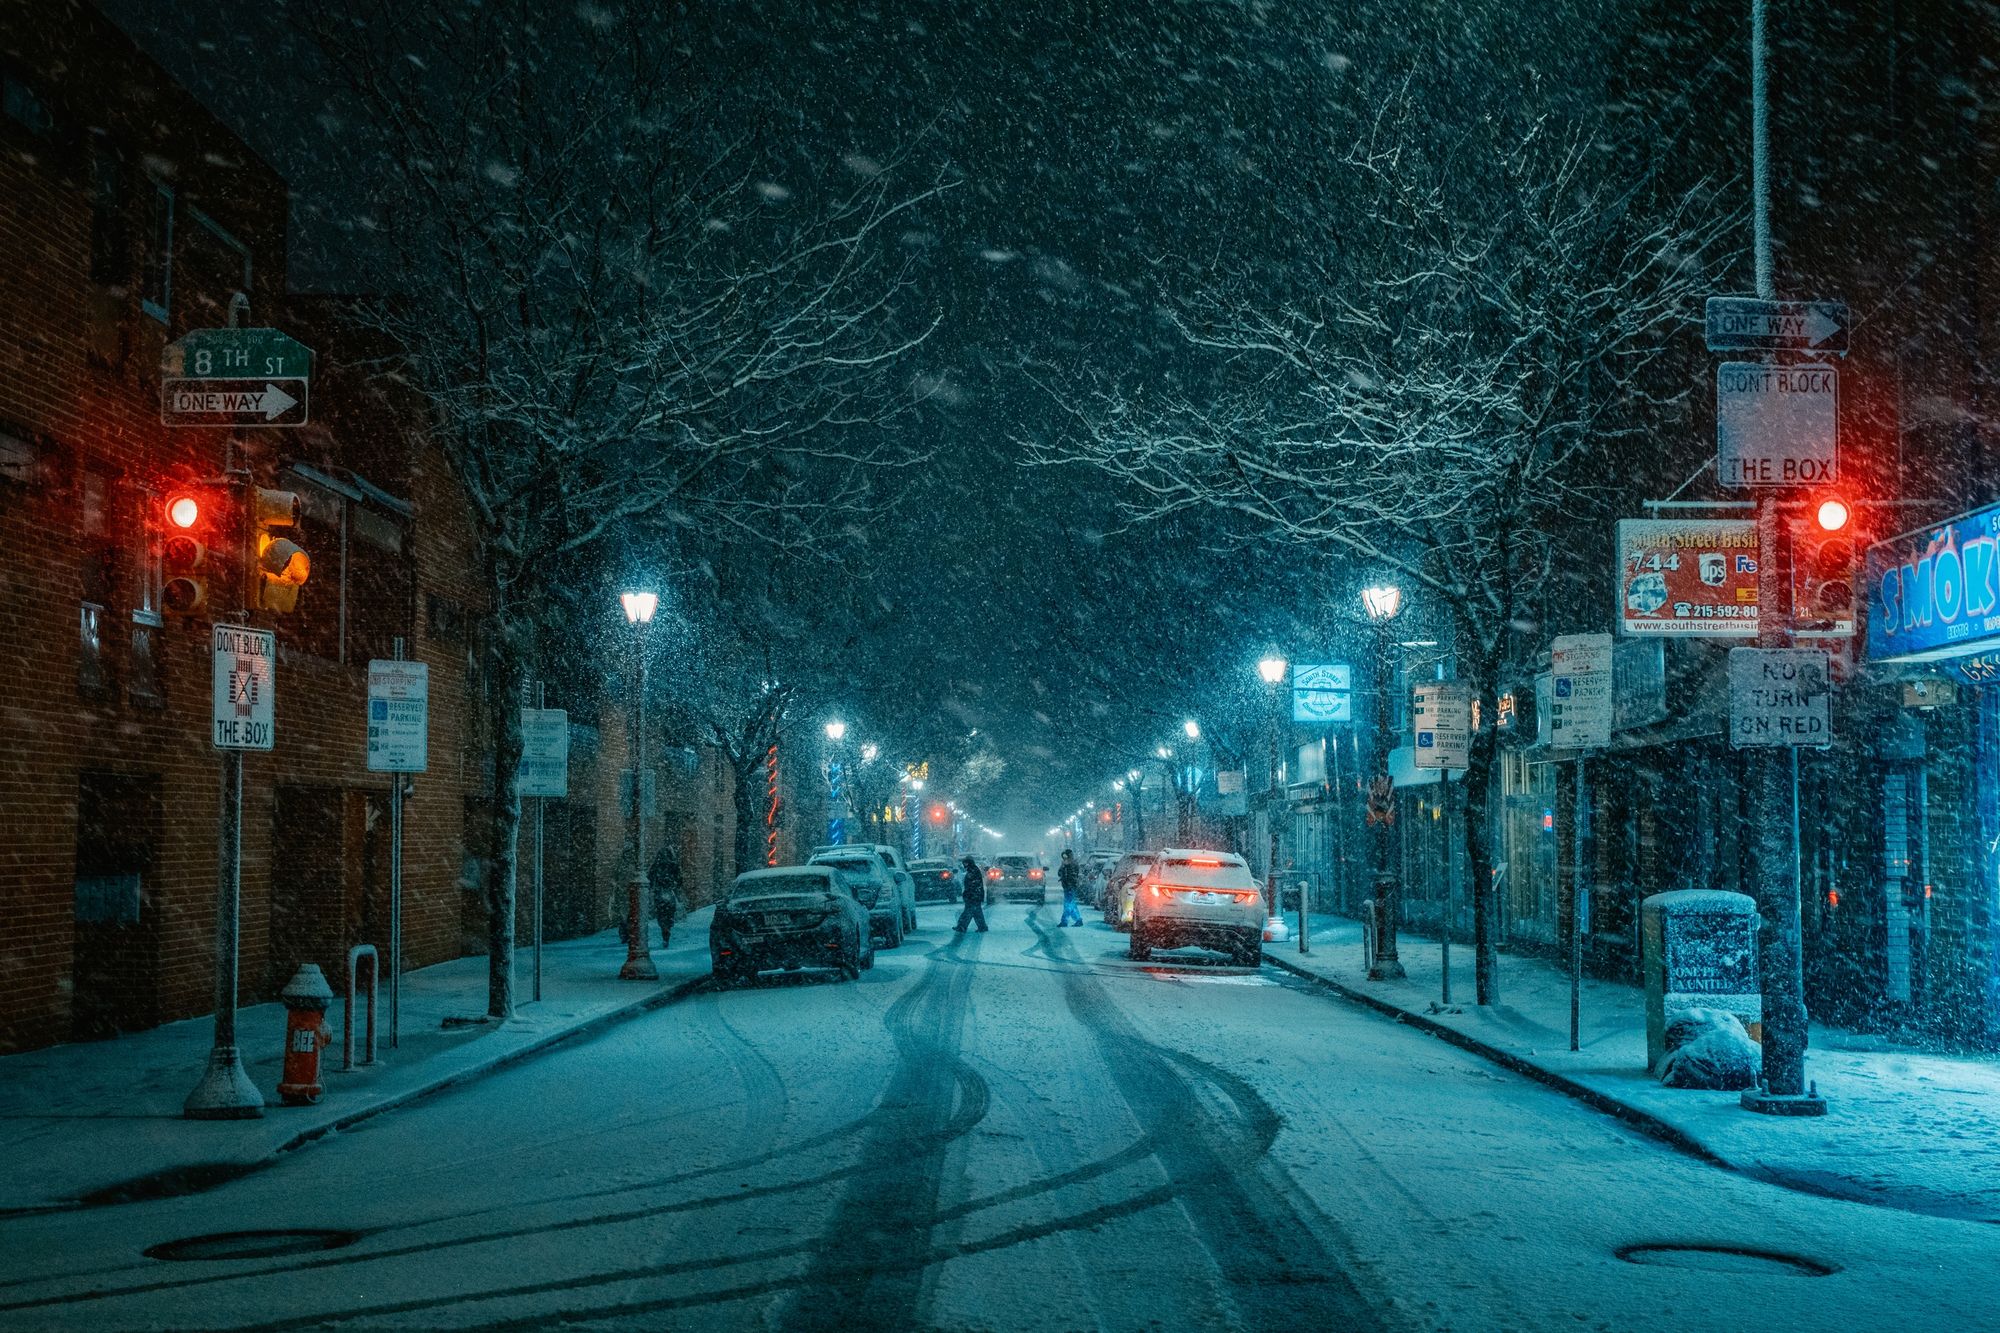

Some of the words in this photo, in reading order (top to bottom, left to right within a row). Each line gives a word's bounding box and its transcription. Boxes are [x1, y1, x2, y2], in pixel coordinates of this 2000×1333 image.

[1723, 316, 1759, 333] ONE
[1768, 317, 1804, 334] WAY
[195, 350, 212, 374] 8
[223, 349, 248, 366] TH
[265, 357, 284, 375] ST
[1779, 373, 1831, 393] BLOCK
[179, 394, 216, 410] ONE
[224, 394, 264, 410] WAY
[1728, 458, 1771, 480] THE
[1784, 459, 1831, 480] BOX
[1676, 531, 1718, 548] Street
[1630, 552, 1680, 571] 744
[1736, 555, 1758, 573] Fe
[1881, 534, 2000, 634] SMOK
[1947, 622, 1968, 639] EXOTIC
[244, 634, 271, 657] BLOCK
[1763, 662, 1796, 680] NO
[1752, 689, 1809, 707] TURN
[389, 702, 424, 713] RESERVED
[390, 713, 422, 722] PARKING
[1741, 716, 1769, 734] ON
[1780, 716, 1821, 734] RED
[217, 720, 239, 743] THE
[245, 722, 269, 745] BOX
[1435, 732, 1467, 741] RESERVED
[1437, 741, 1465, 750] PARKING
